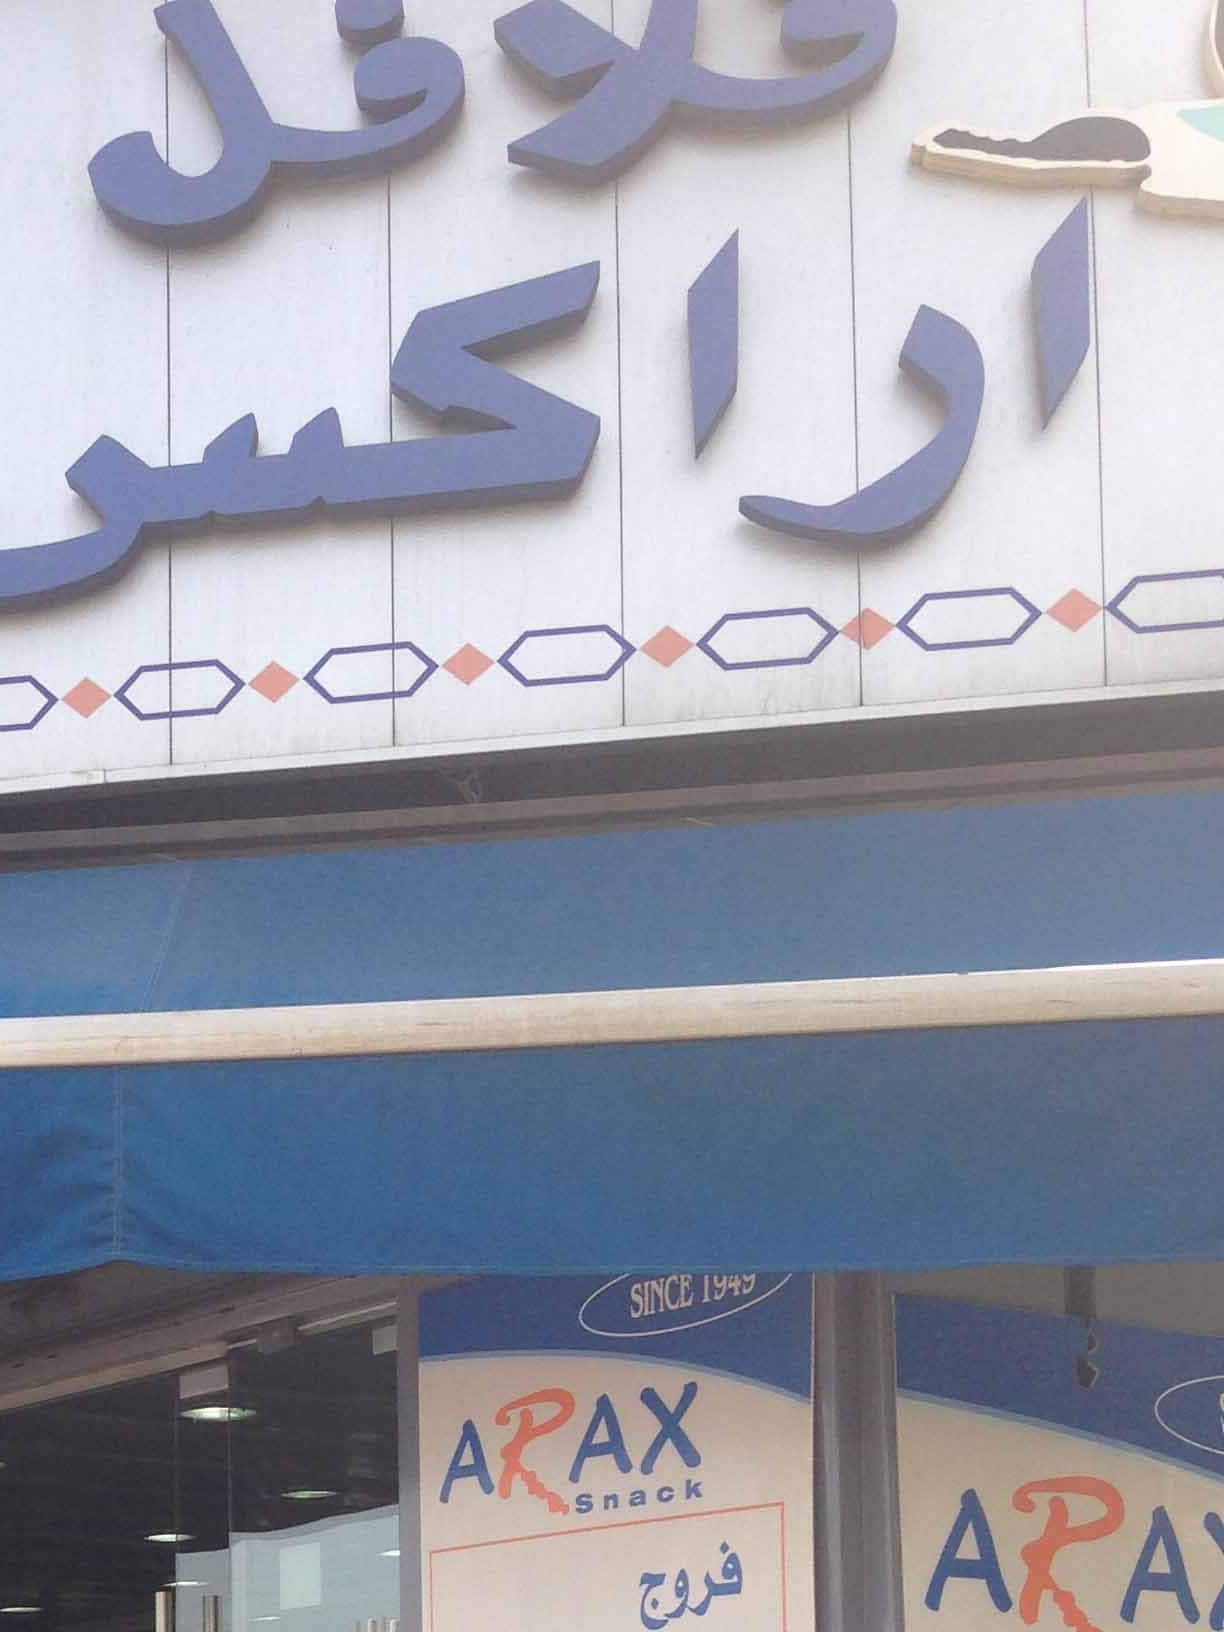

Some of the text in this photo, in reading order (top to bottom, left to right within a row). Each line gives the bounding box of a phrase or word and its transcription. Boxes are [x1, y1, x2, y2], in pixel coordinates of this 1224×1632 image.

[630, 1273, 694, 1319] SINCE
[439, 1381, 702, 1516] ARAX
[638, 1540, 744, 1630] فروج
